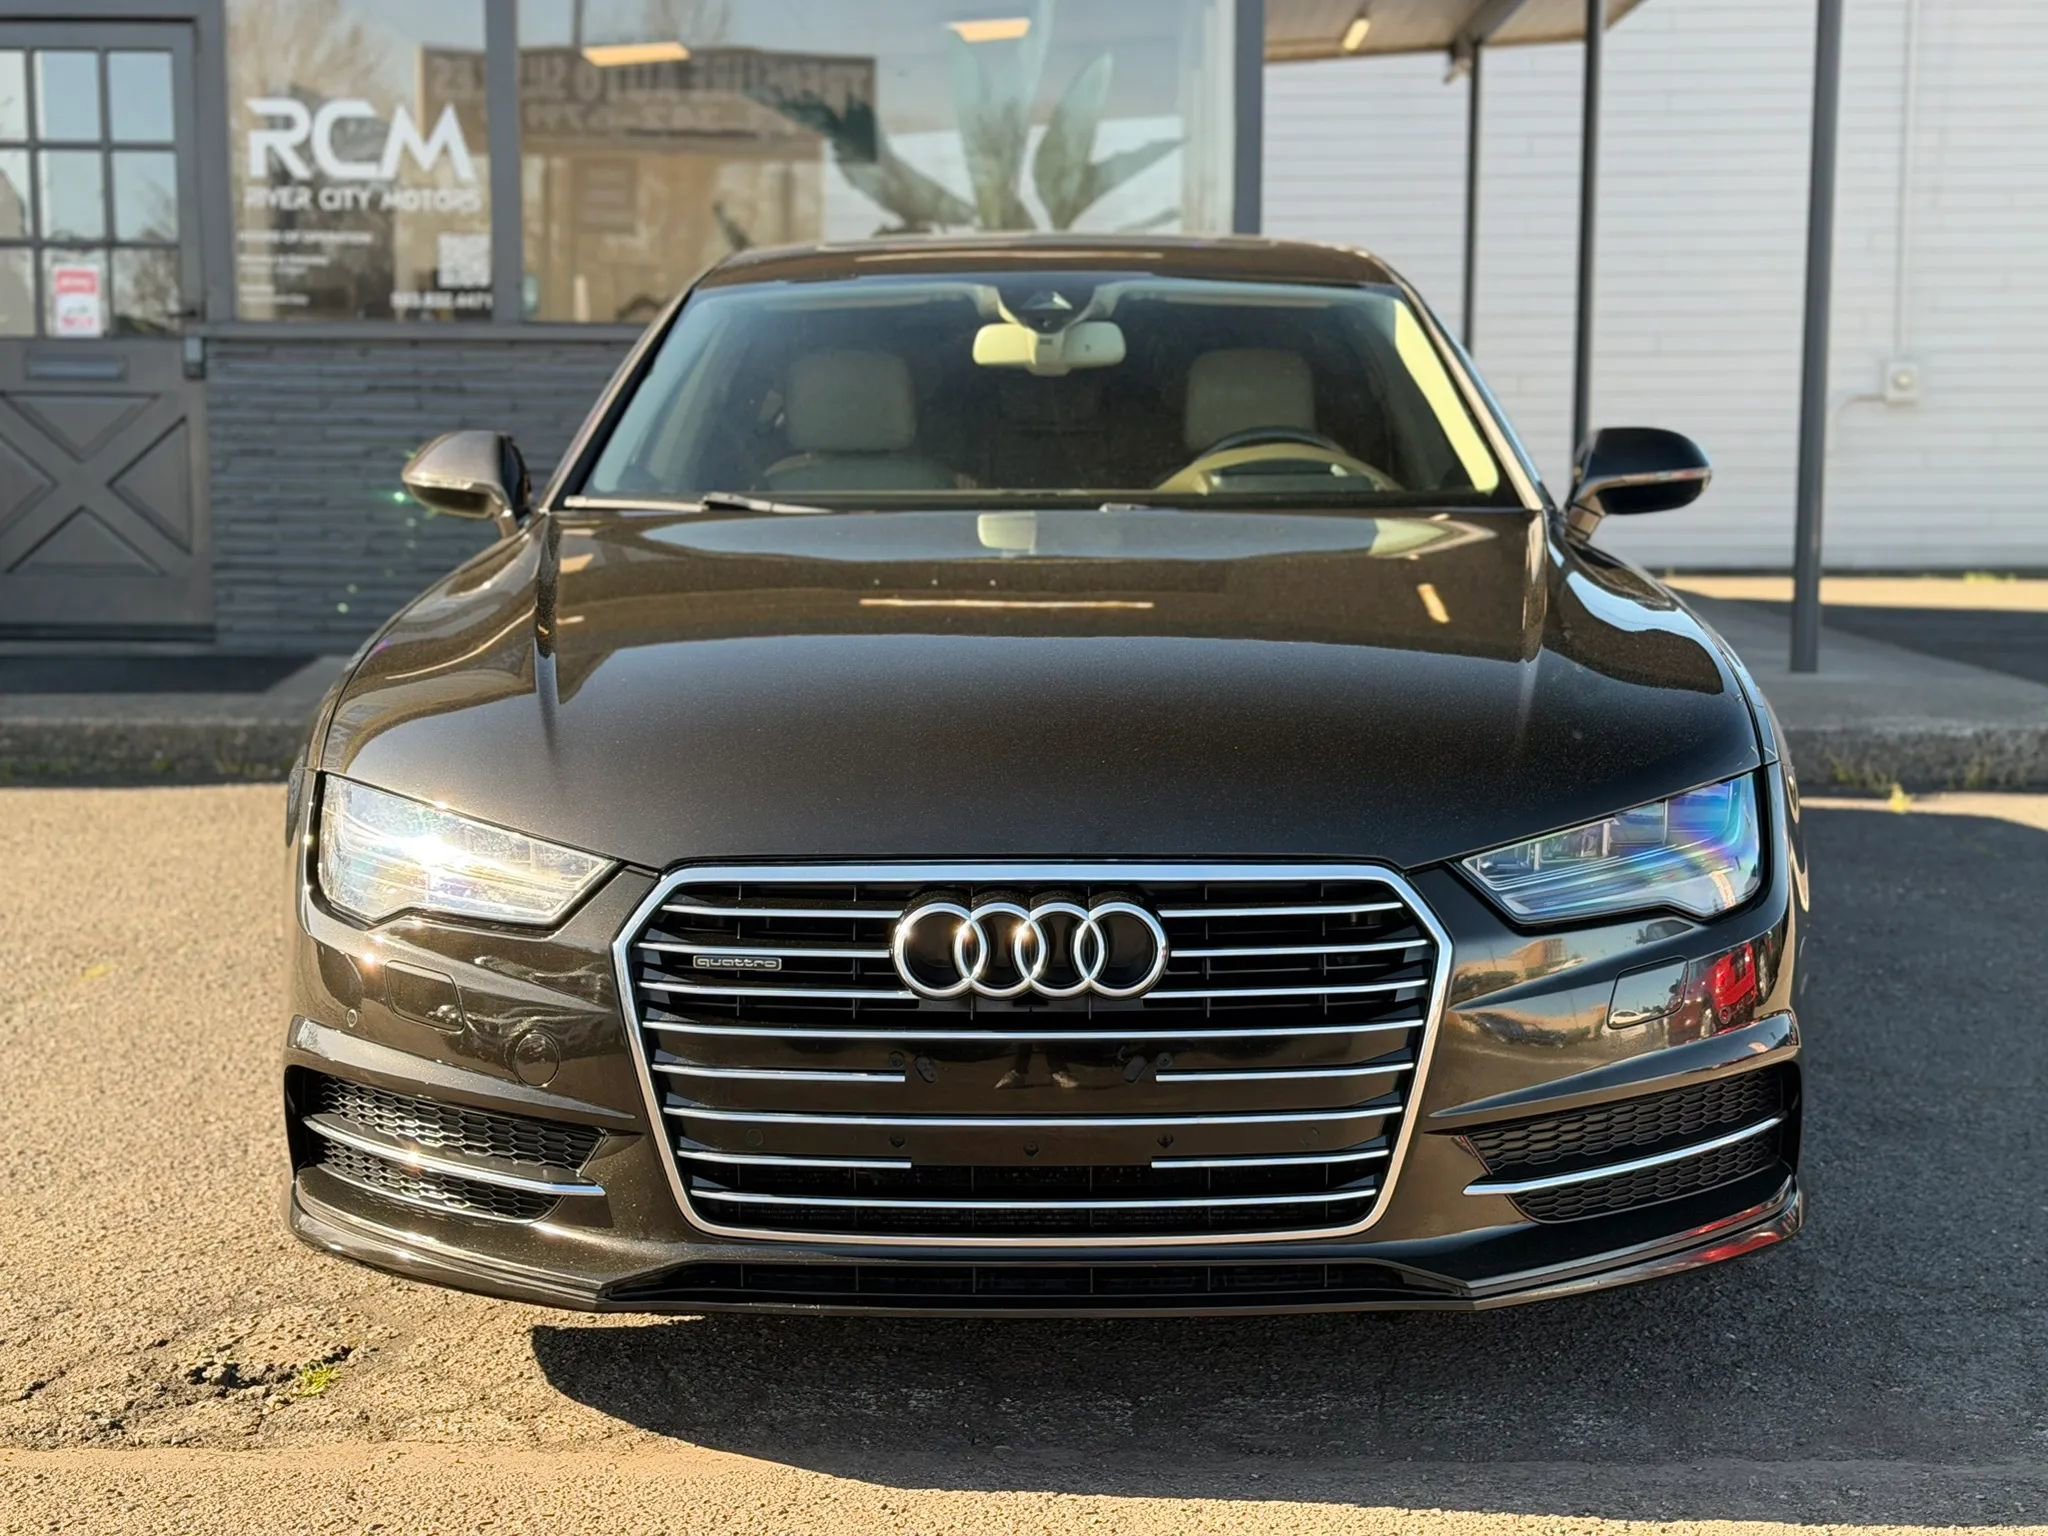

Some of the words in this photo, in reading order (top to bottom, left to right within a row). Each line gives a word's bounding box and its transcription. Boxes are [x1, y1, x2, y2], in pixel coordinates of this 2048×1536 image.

[245, 97, 476, 181] RCM
[318, 186, 373, 211] CITY
[380, 188, 483, 213] MOTORS
[697, 958, 777, 968] quattro
